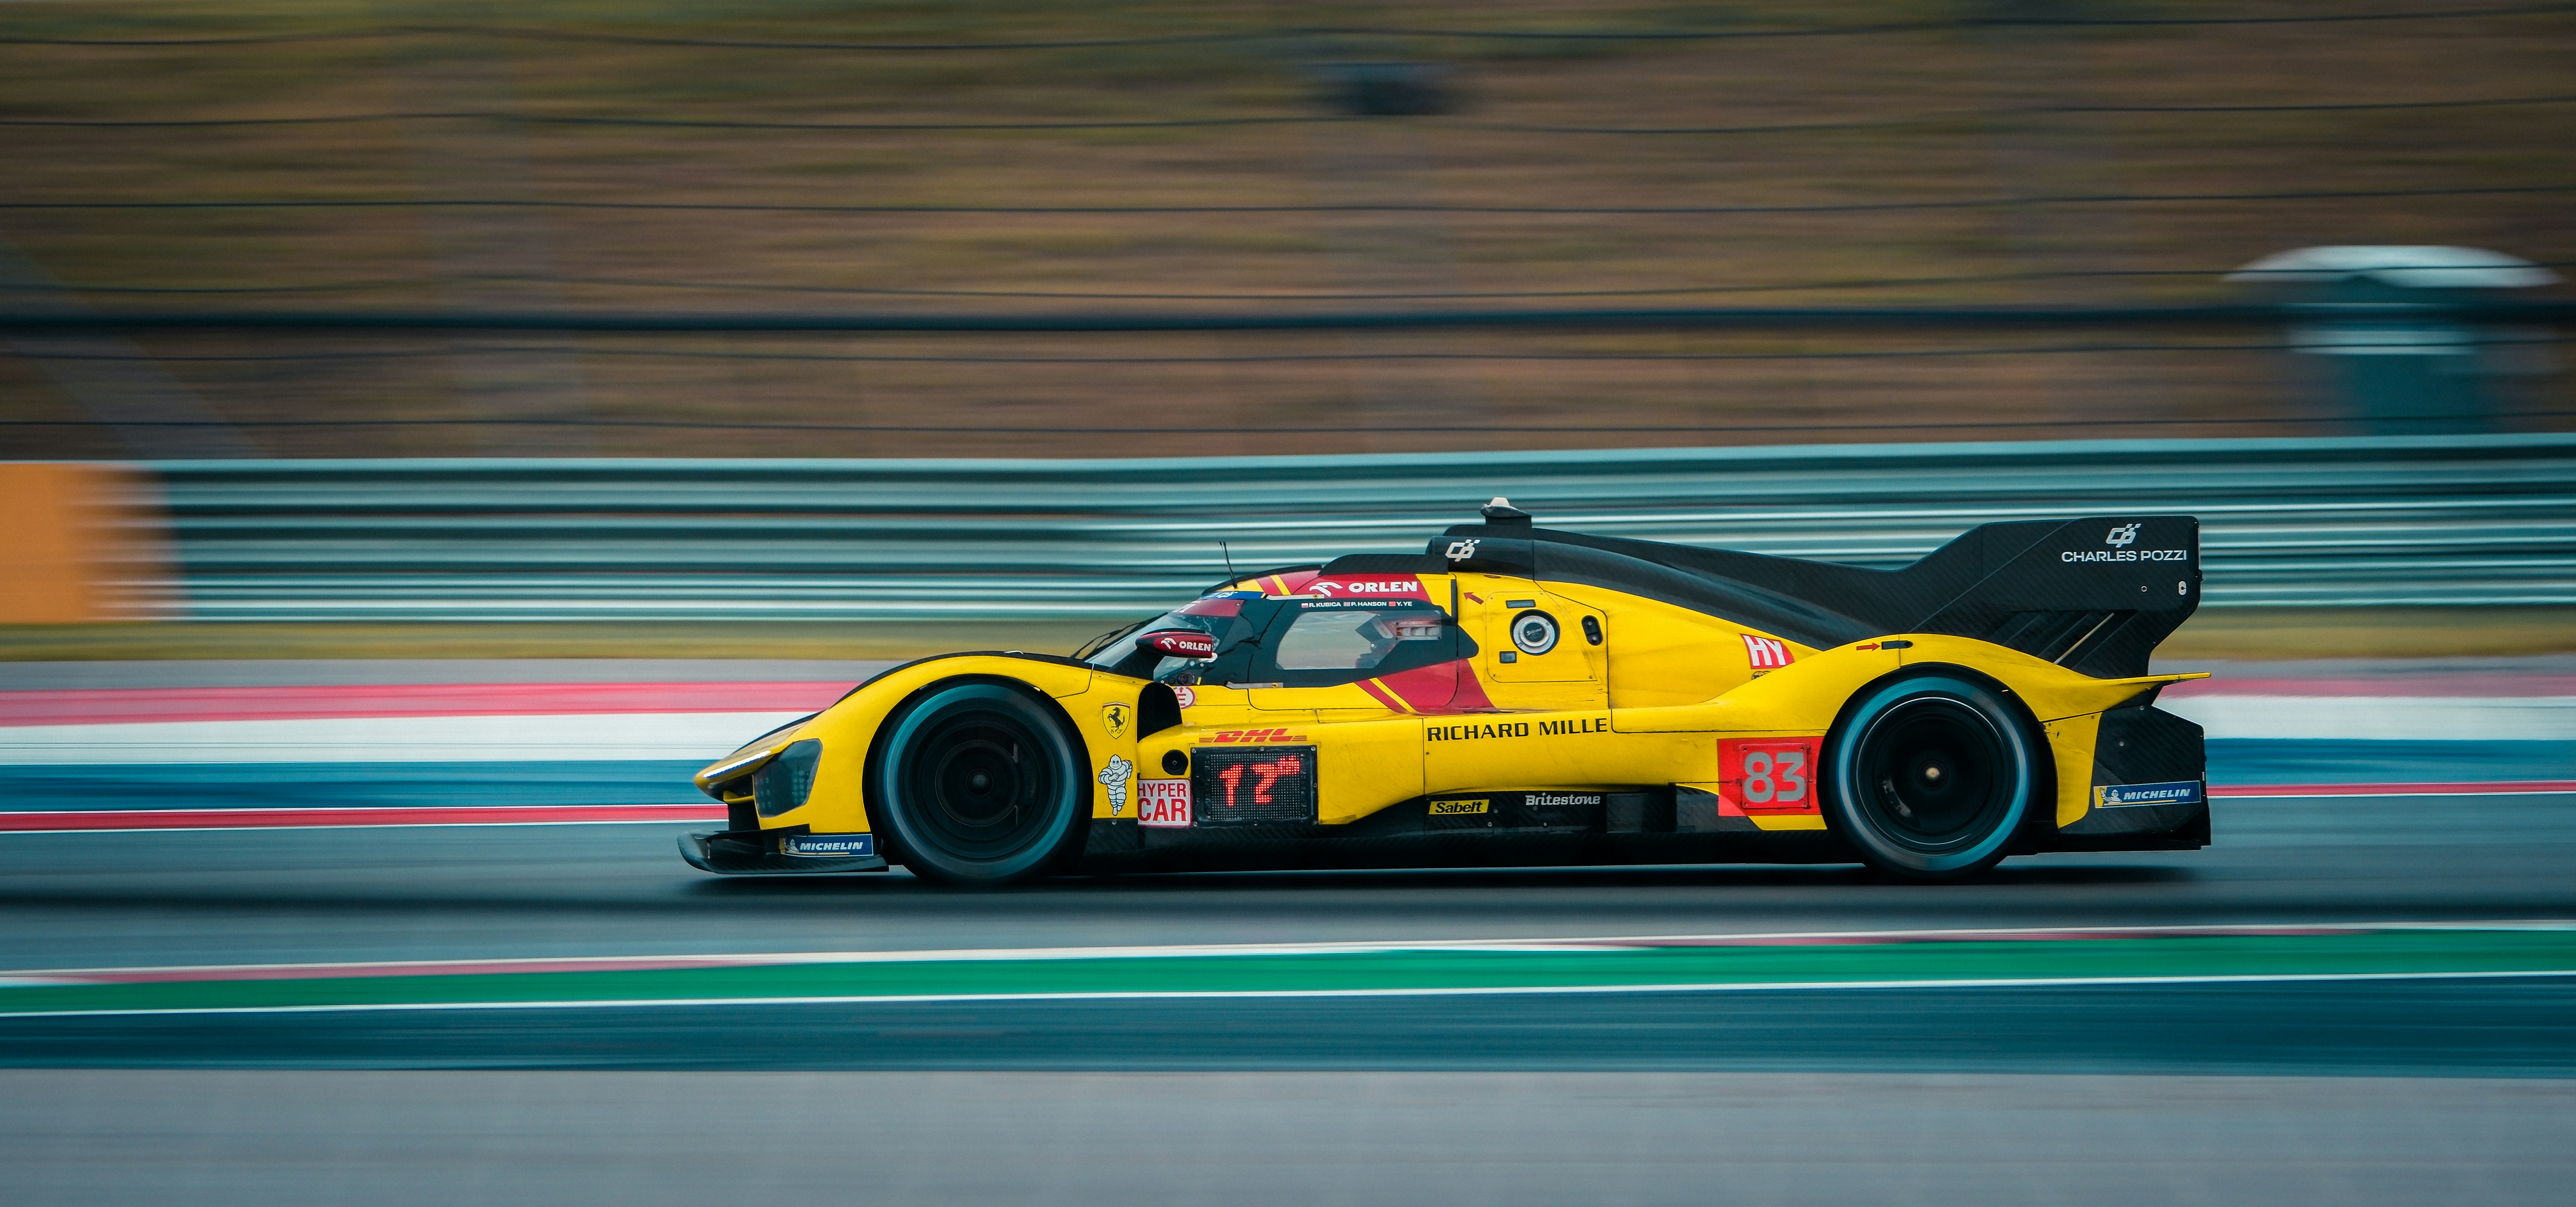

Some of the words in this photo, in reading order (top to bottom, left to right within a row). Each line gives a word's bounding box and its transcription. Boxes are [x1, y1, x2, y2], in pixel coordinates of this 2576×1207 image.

[2062, 551, 2137, 562] CHARLES
[2141, 550, 2187, 561] POZZI
[1349, 581, 1417, 593] ORLEN
[1179, 641, 1211, 652] ORLEN
[1742, 635, 1786, 666] HY
[1213, 729, 1294, 742] DHL
[1427, 723, 1529, 741] RICHARD
[1539, 718, 1607, 736] MILLE
[1744, 751, 1806, 803] 83
[1137, 783, 1187, 797] HYPER
[2123, 789, 2191, 800] MICHELIN
[1525, 793, 1601, 805] Britestone
[1137, 798, 1187, 821] CAR
[1435, 801, 1483, 814] Sabelt
[800, 842, 863, 850] MICHELIN
